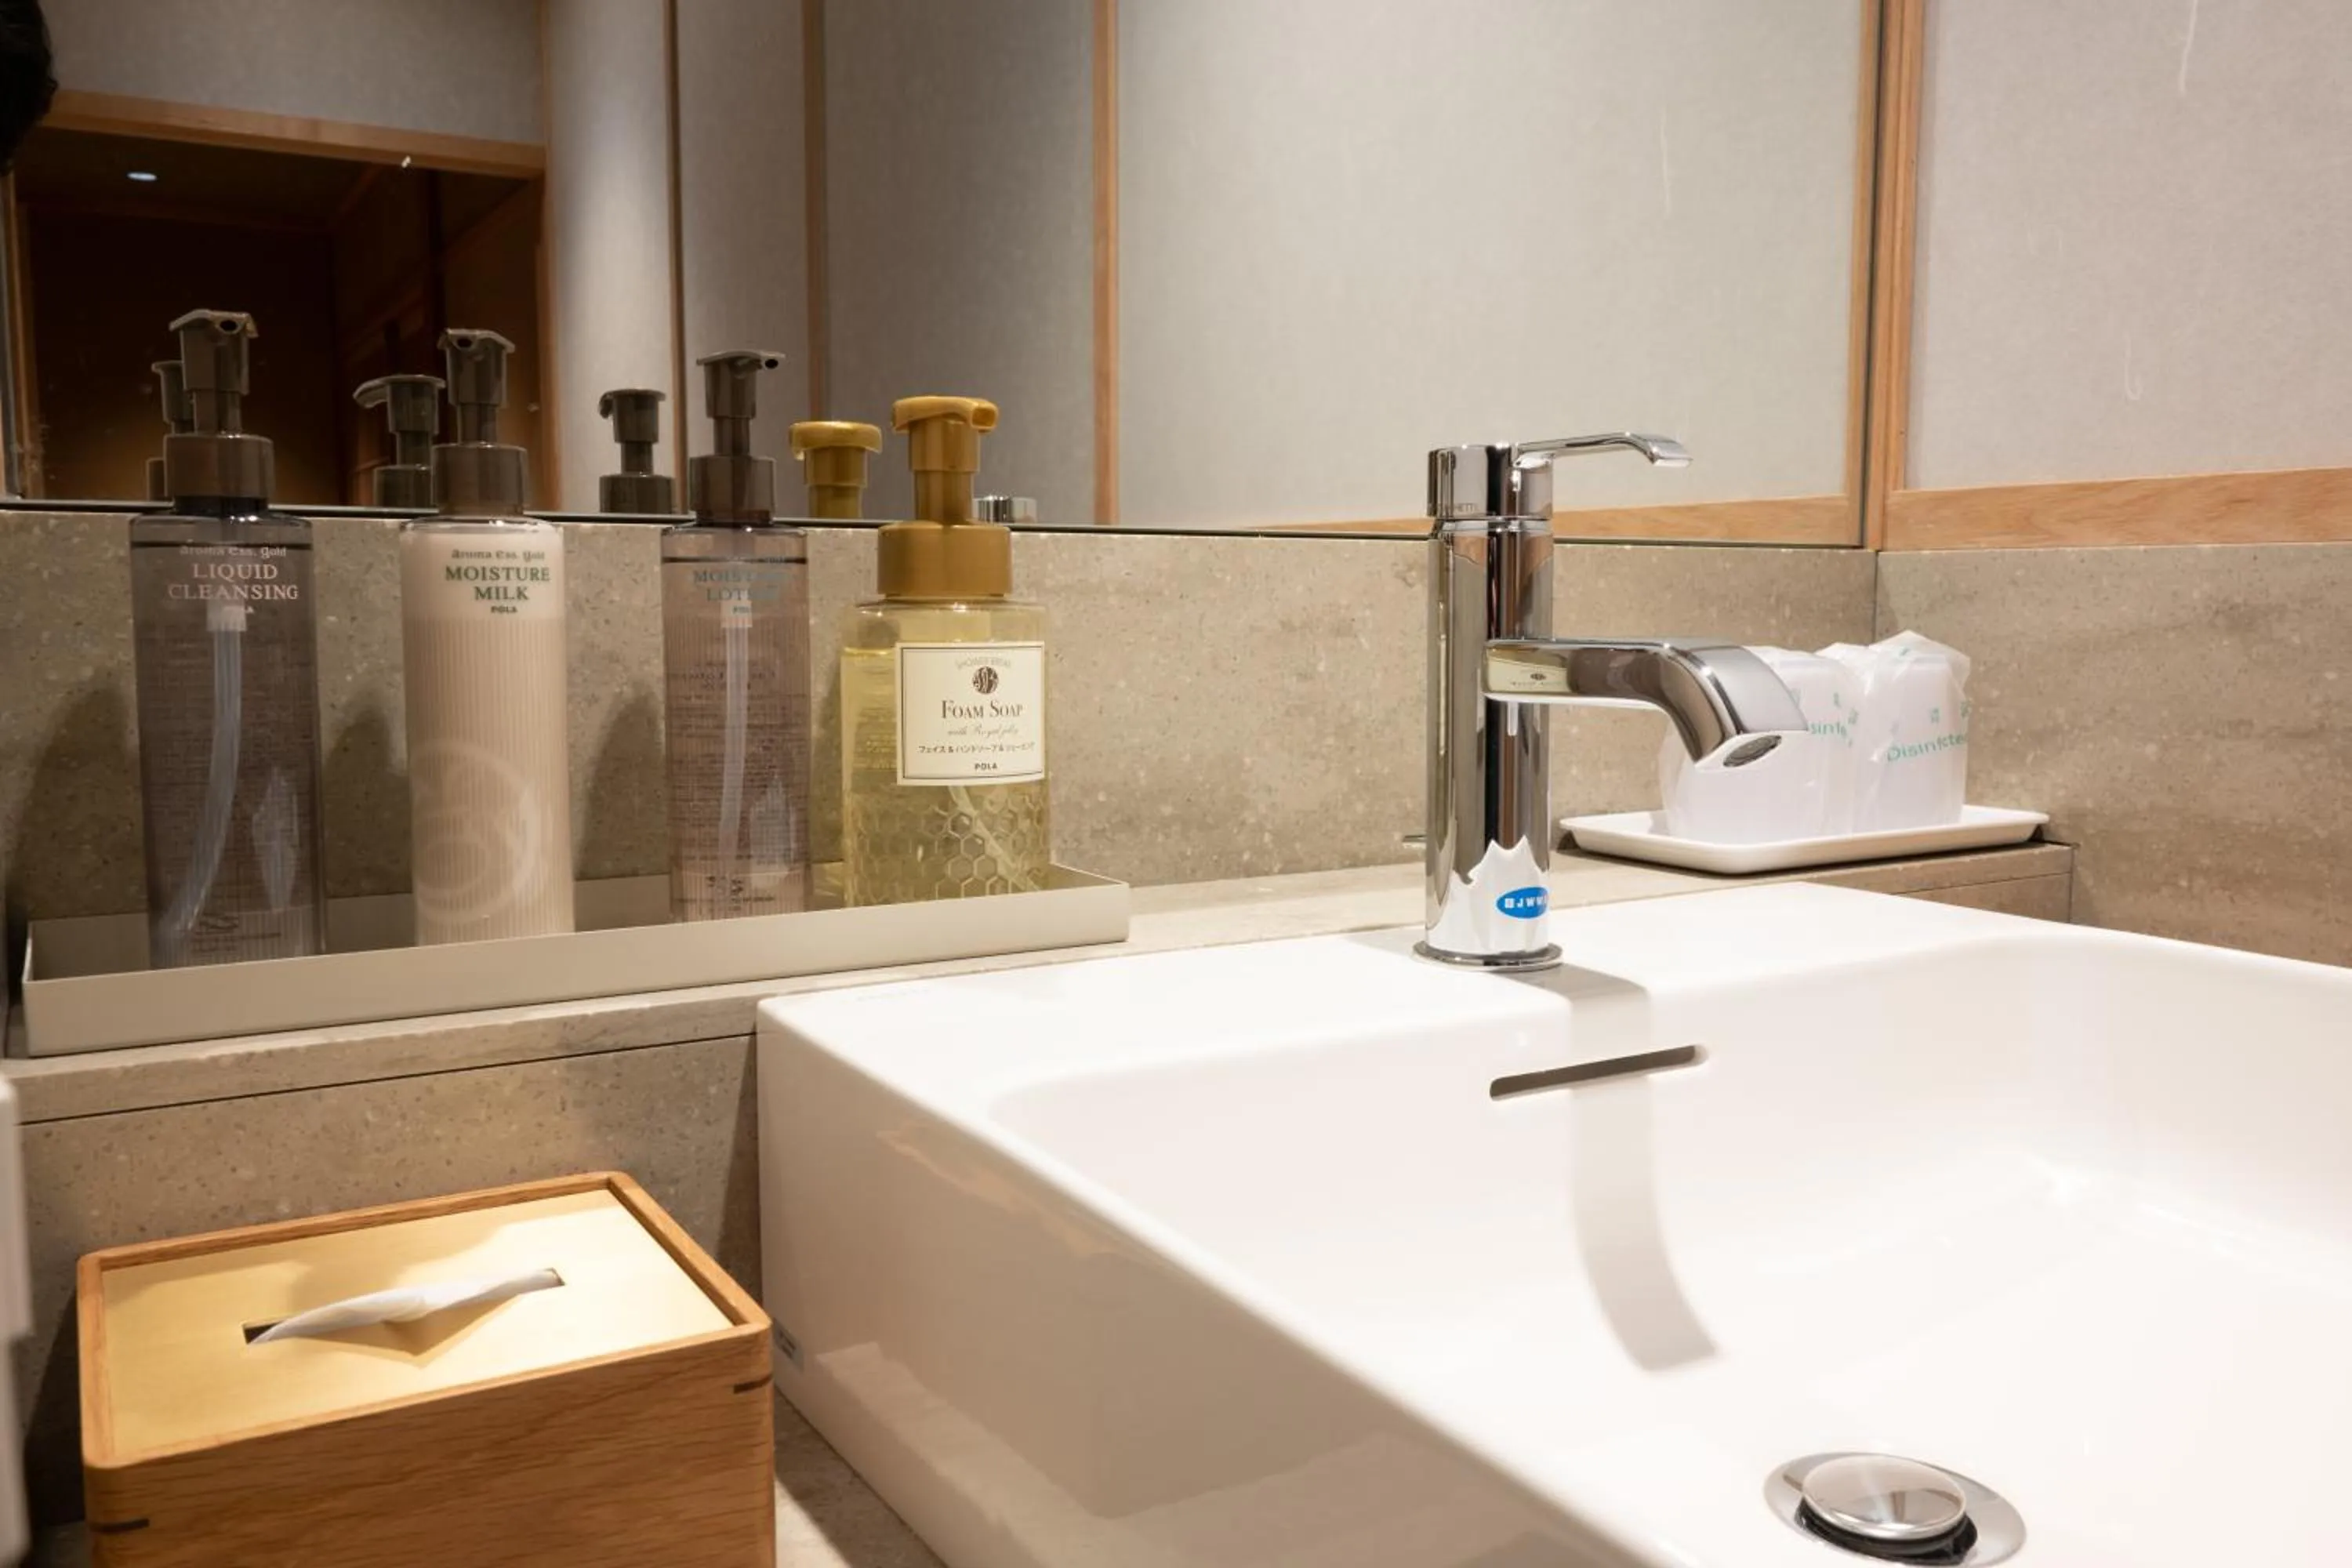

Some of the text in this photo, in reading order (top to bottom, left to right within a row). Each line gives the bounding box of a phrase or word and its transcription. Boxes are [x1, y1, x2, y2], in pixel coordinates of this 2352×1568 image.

[193, 563, 278, 582] LIQUID
[445, 565, 551, 581] MOISTURE
[168, 584, 299, 600] CLEANSING
[474, 586, 529, 601] MILK
[941, 699, 1023, 719] FOAM SOAP
